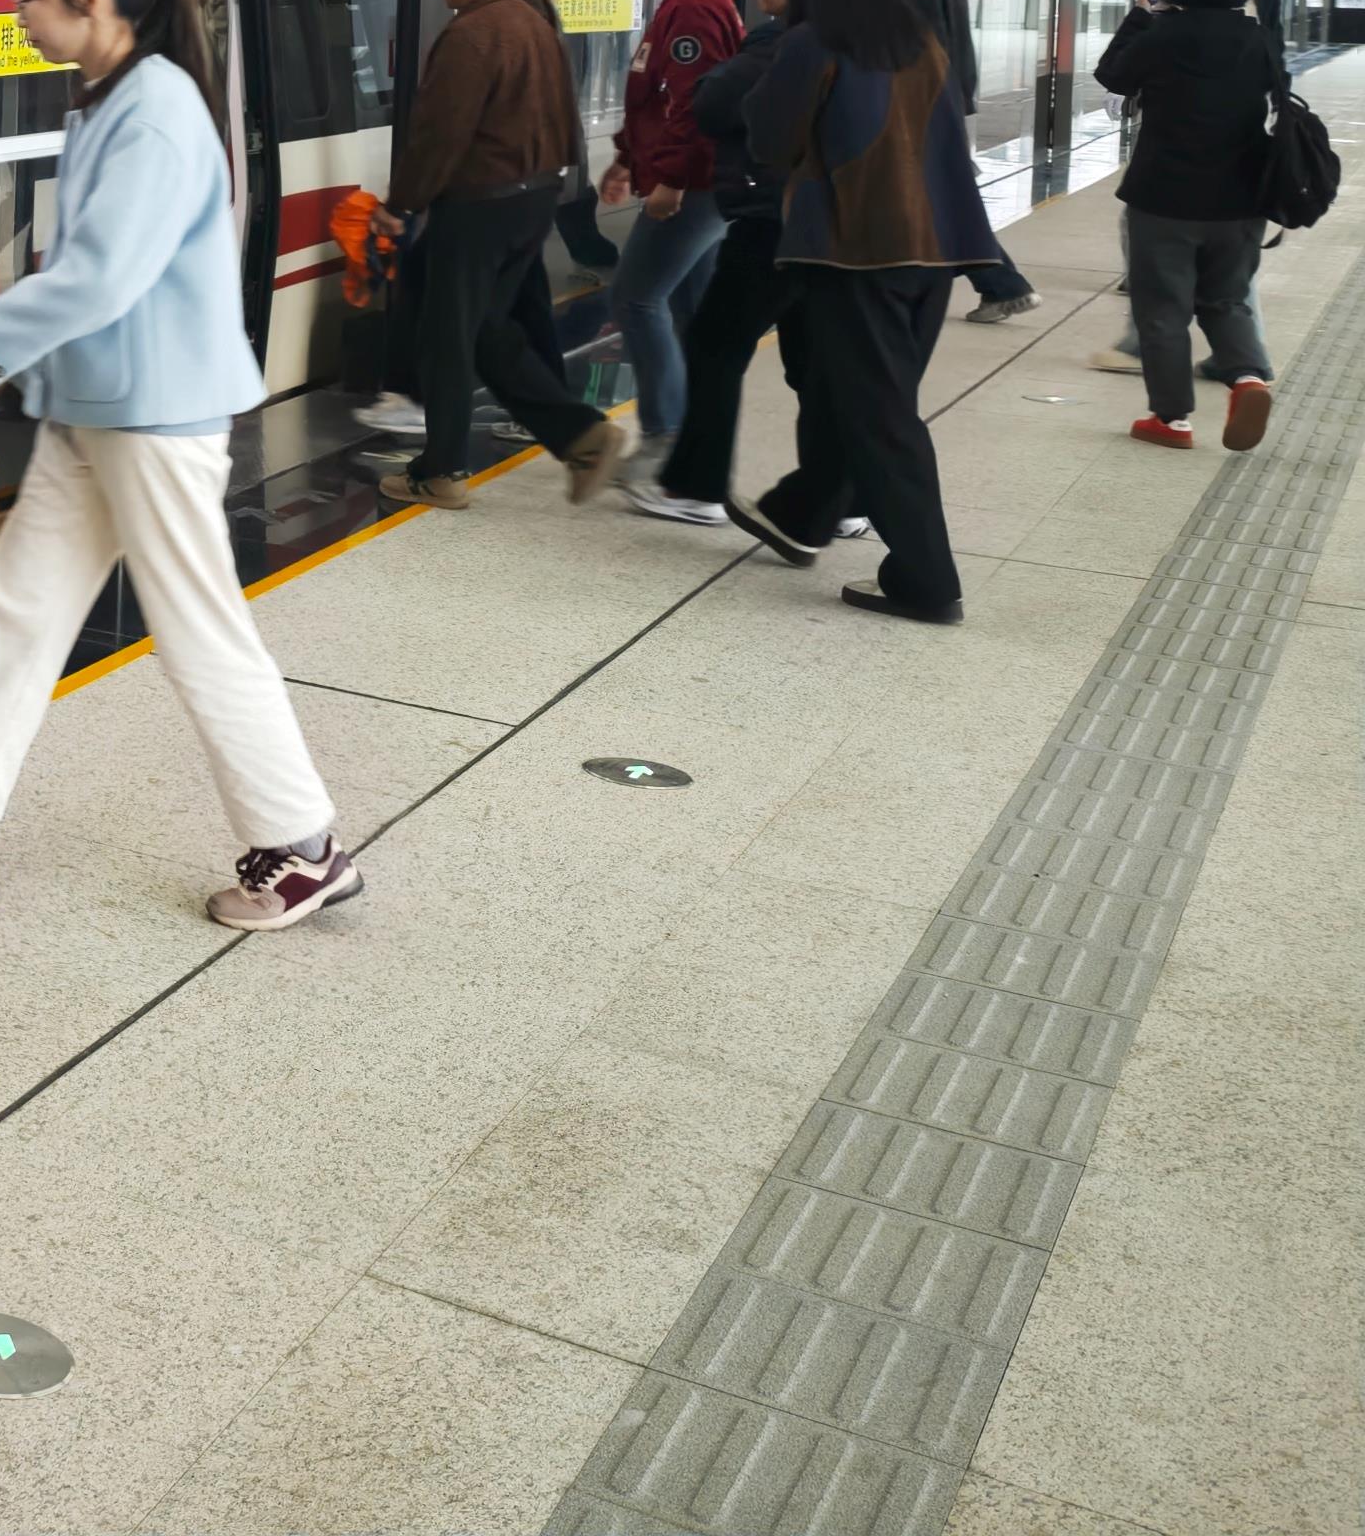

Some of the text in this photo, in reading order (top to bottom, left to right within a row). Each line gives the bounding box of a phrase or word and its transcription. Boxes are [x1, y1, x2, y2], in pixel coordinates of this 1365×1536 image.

[680, 43, 693, 58] G
[7, 56, 18, 67] the
[19, 54, 39, 67] yellow
